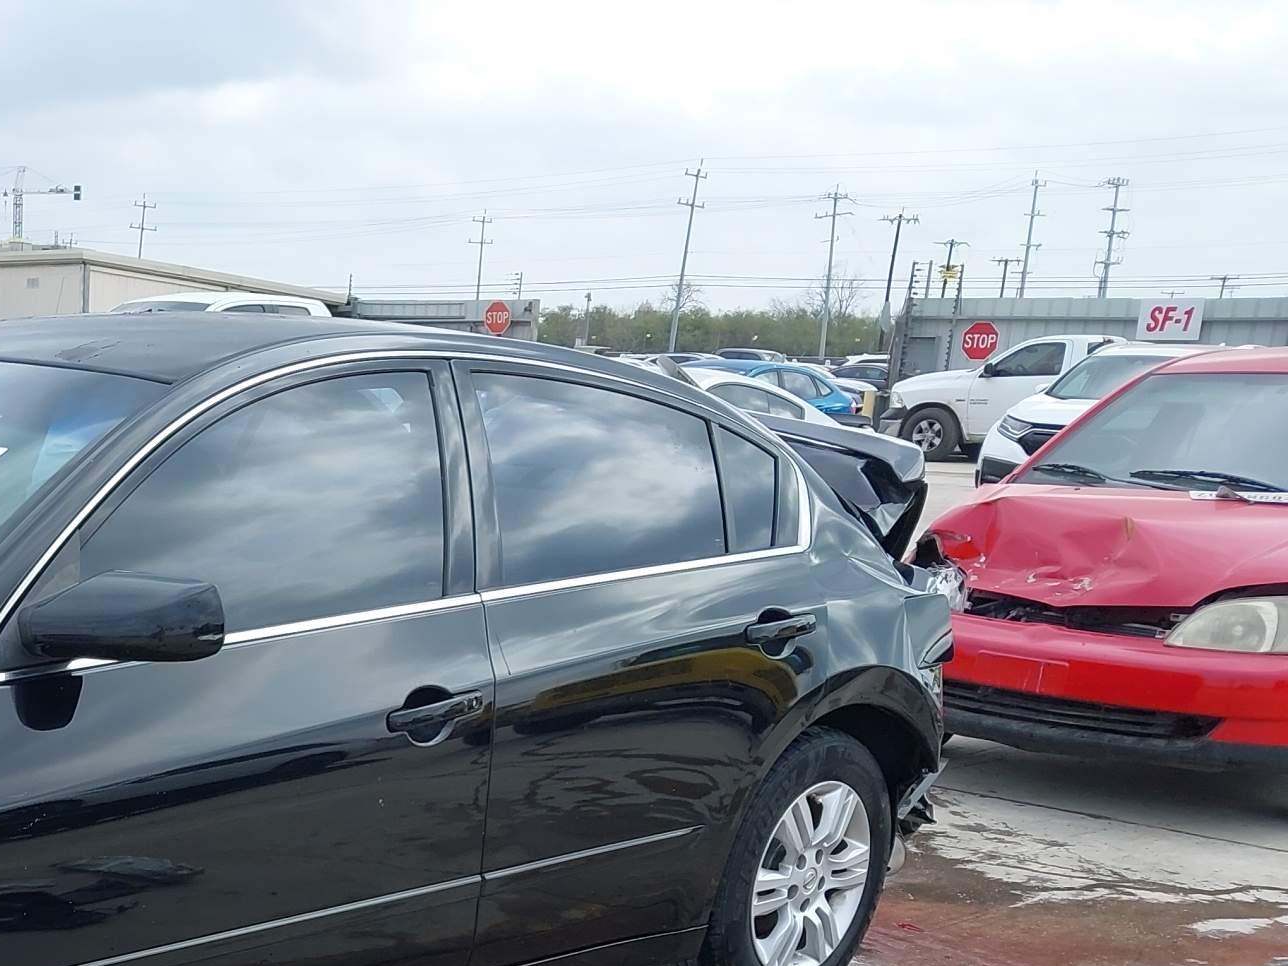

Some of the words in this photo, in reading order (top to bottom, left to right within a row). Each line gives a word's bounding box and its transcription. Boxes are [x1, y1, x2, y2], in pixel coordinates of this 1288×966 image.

[486, 311, 509, 324] STOP
[1145, 306, 1195, 332] SF-1
[964, 334, 997, 349] STOP
